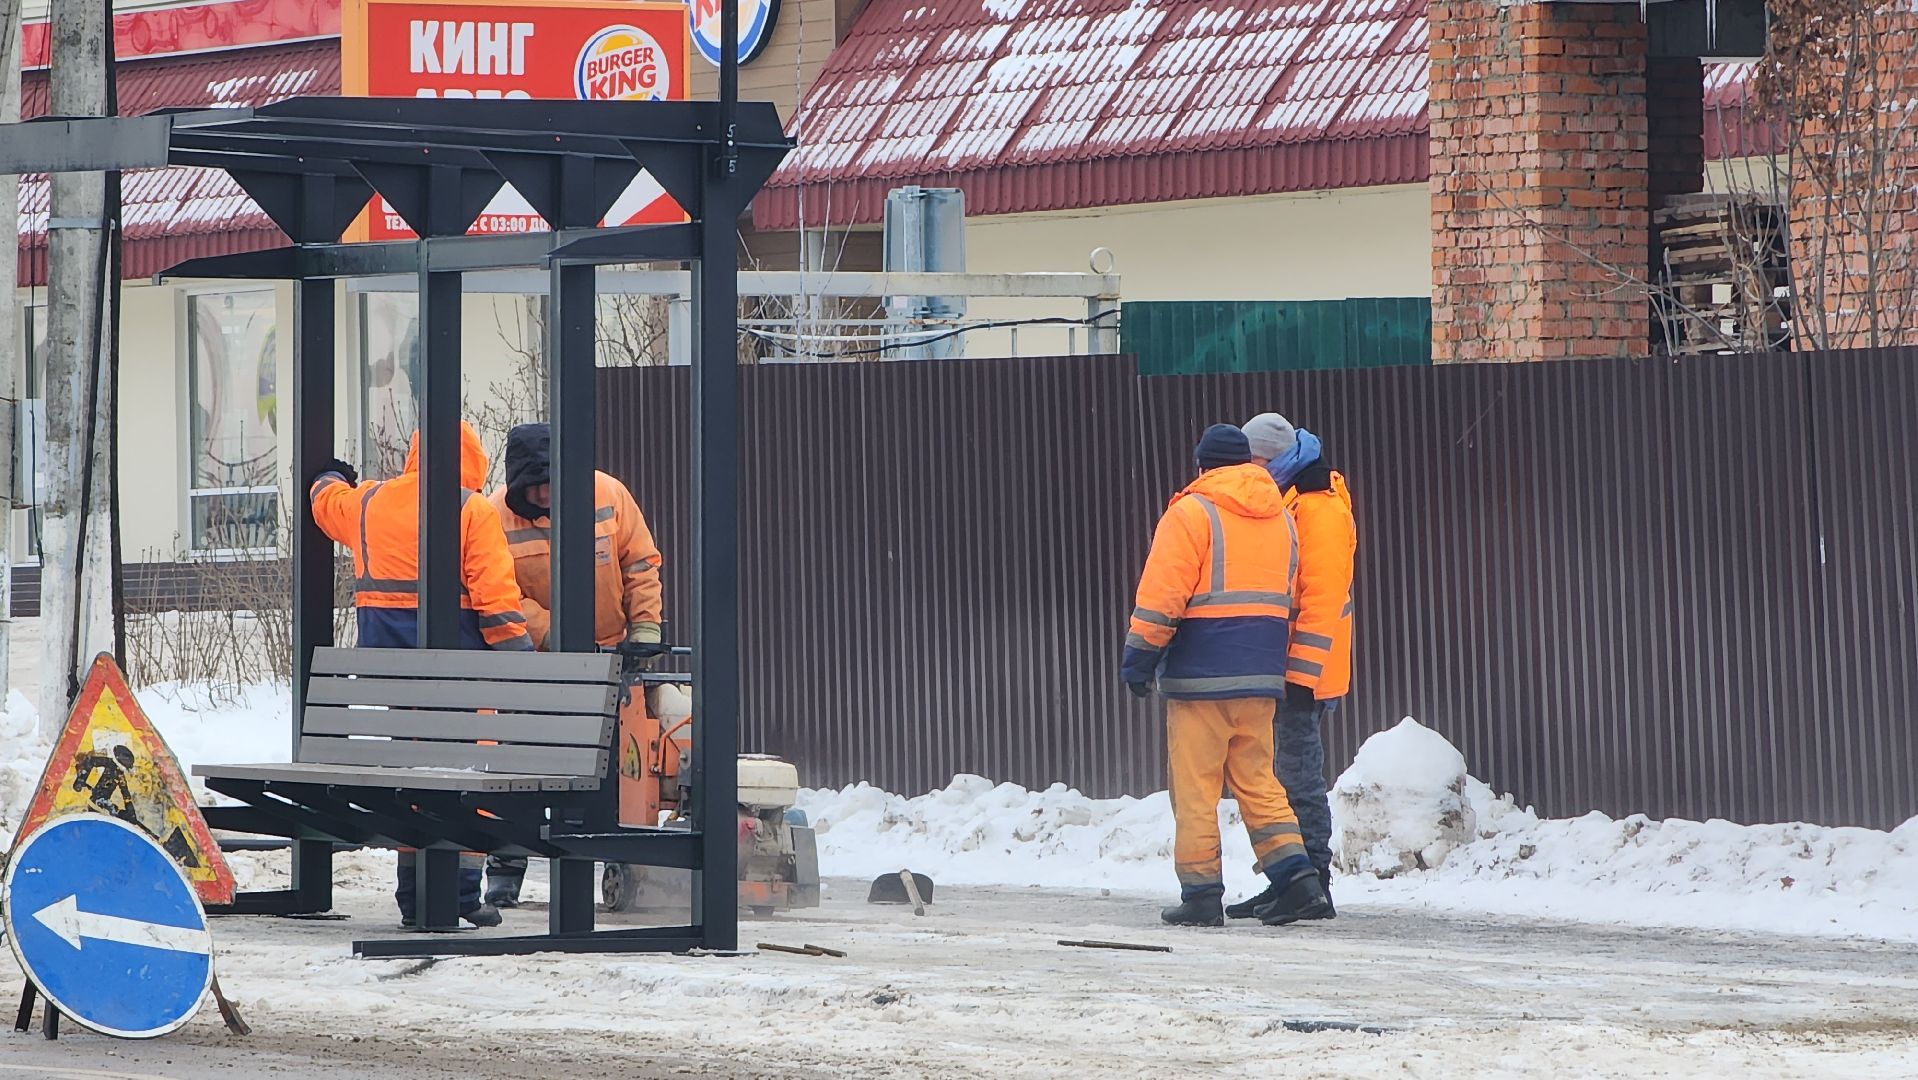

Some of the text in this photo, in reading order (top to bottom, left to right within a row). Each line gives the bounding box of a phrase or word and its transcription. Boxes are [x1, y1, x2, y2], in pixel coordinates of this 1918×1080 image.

[410, 20, 534, 75] КИНГ
[587, 46, 655, 81] BURGER
[590, 64, 657, 99] KING
[480, 216, 488, 232] С
[490, 216, 527, 232] 03:00
